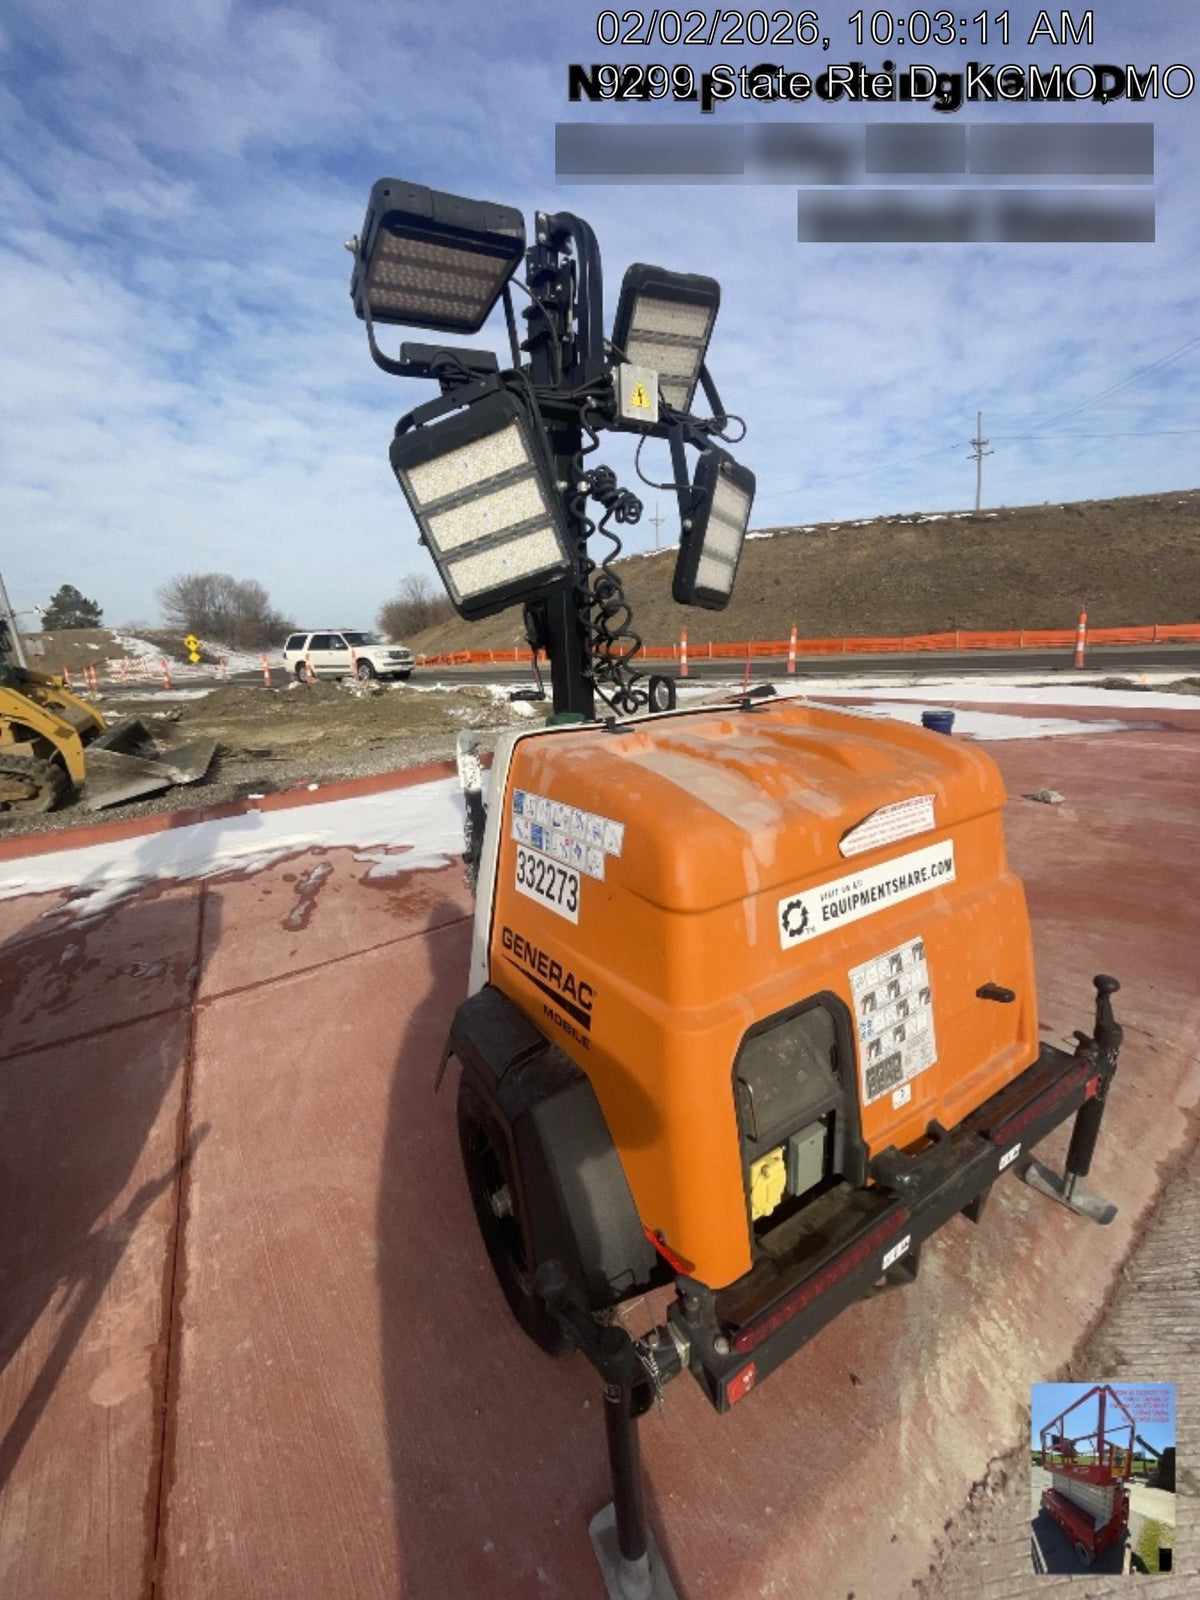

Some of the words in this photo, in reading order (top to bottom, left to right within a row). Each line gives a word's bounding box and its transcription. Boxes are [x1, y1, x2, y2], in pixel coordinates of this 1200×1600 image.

[517, 850, 579, 913] 332273
[822, 858, 953, 922] EQUIPMENTSHARE.COM
[502, 926, 594, 1010] GENERAC
[543, 1004, 591, 1052] MOBILE
